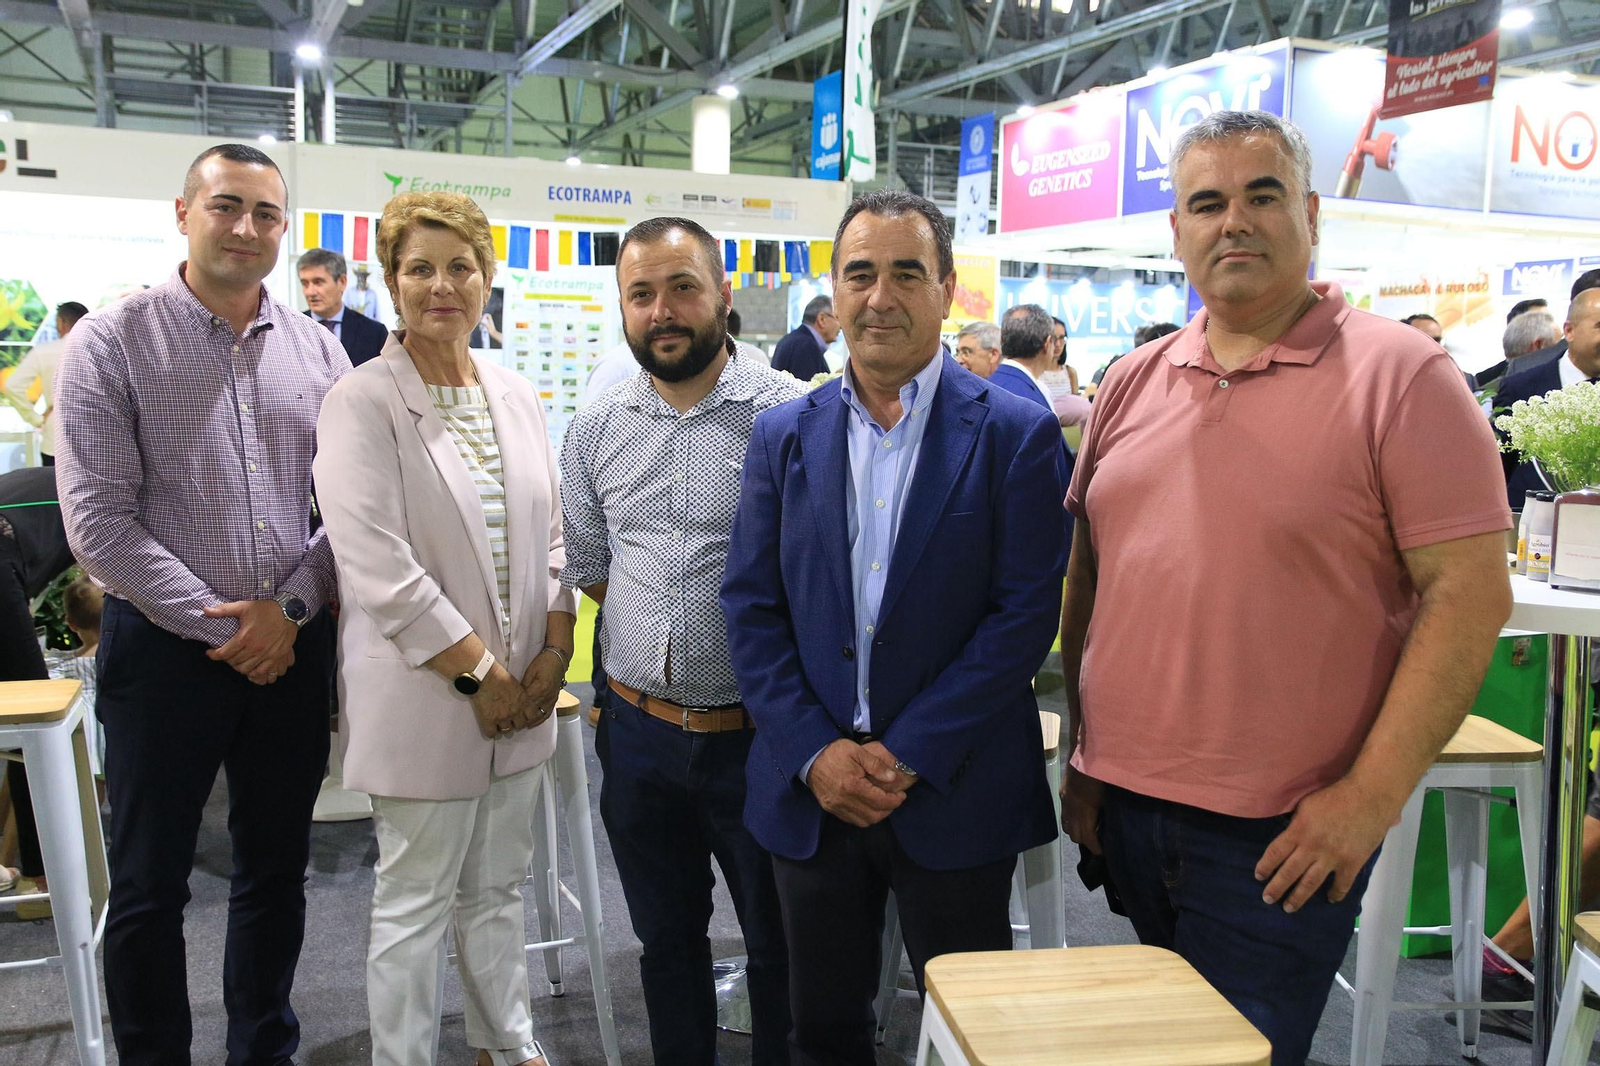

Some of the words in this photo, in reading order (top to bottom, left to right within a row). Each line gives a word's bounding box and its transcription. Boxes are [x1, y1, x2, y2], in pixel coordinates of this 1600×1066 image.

[1436, 47, 1478, 70] siempre
[1386, 82, 1399, 99] al
[1399, 78, 1421, 96] lado
[1421, 71, 1439, 90] del
[1440, 59, 1494, 89] agricultor
[410, 177, 512, 201] Ecotrampa
[1028, 167, 1094, 198] GENETICS
[548, 186, 632, 205] ECOTRAMPA
[530, 276, 604, 293] Ecotrampa
